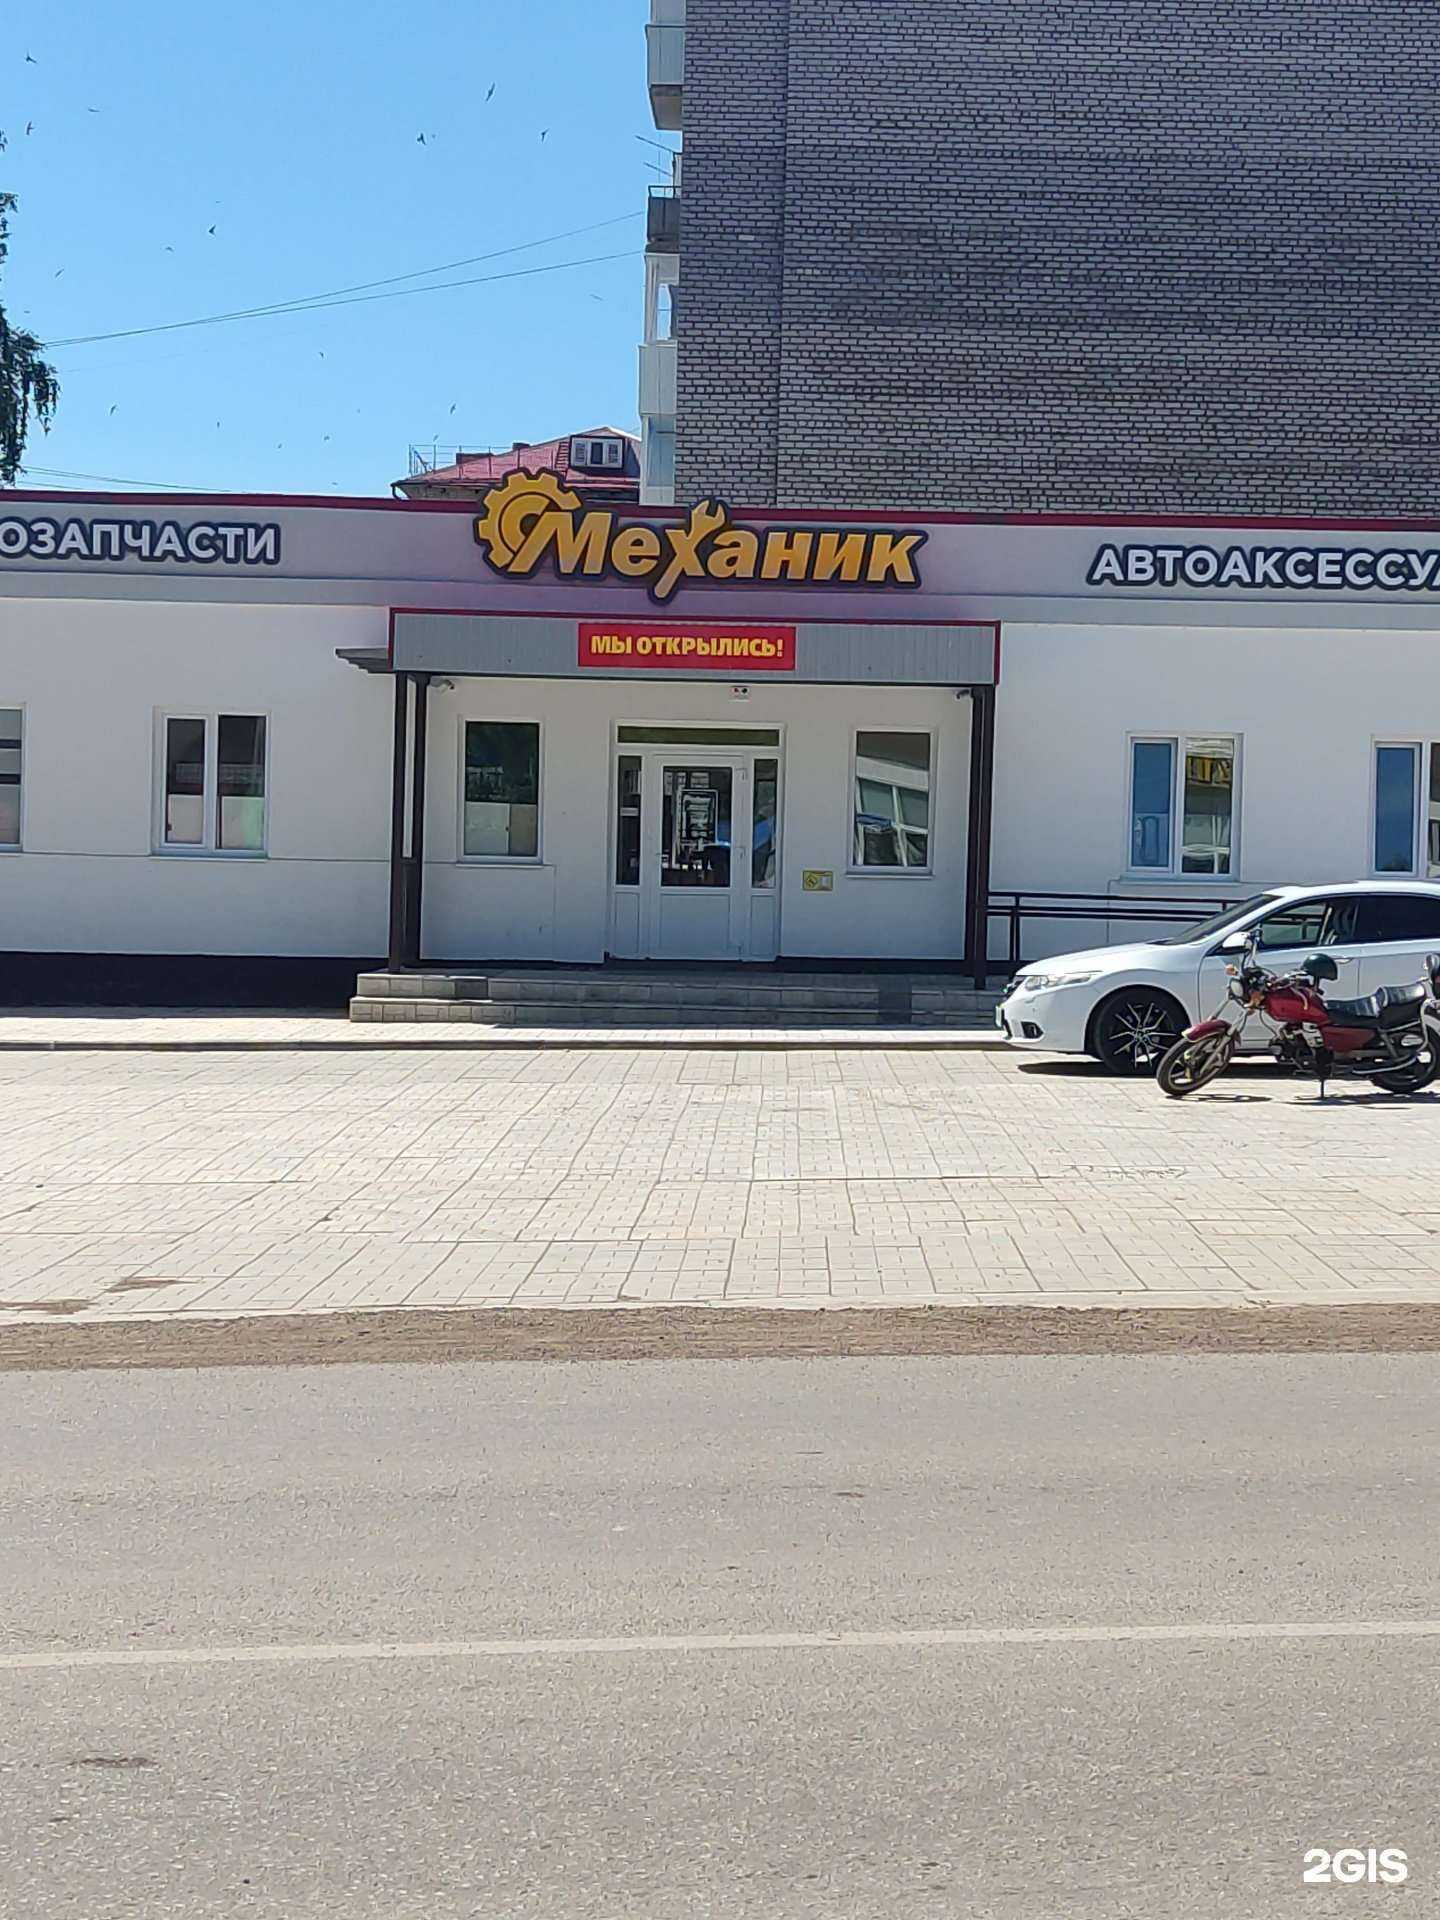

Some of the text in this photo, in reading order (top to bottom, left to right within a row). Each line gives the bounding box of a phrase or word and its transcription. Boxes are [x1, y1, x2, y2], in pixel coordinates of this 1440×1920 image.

[0, 520, 277, 561] ОЗАПЧАСТИ
[501, 496, 924, 600] Механик
[1091, 547, 1440, 587] АВТОАКСЕССУ
[590, 635, 784, 657] МЫ ОТКРЫЛИСЬ!
